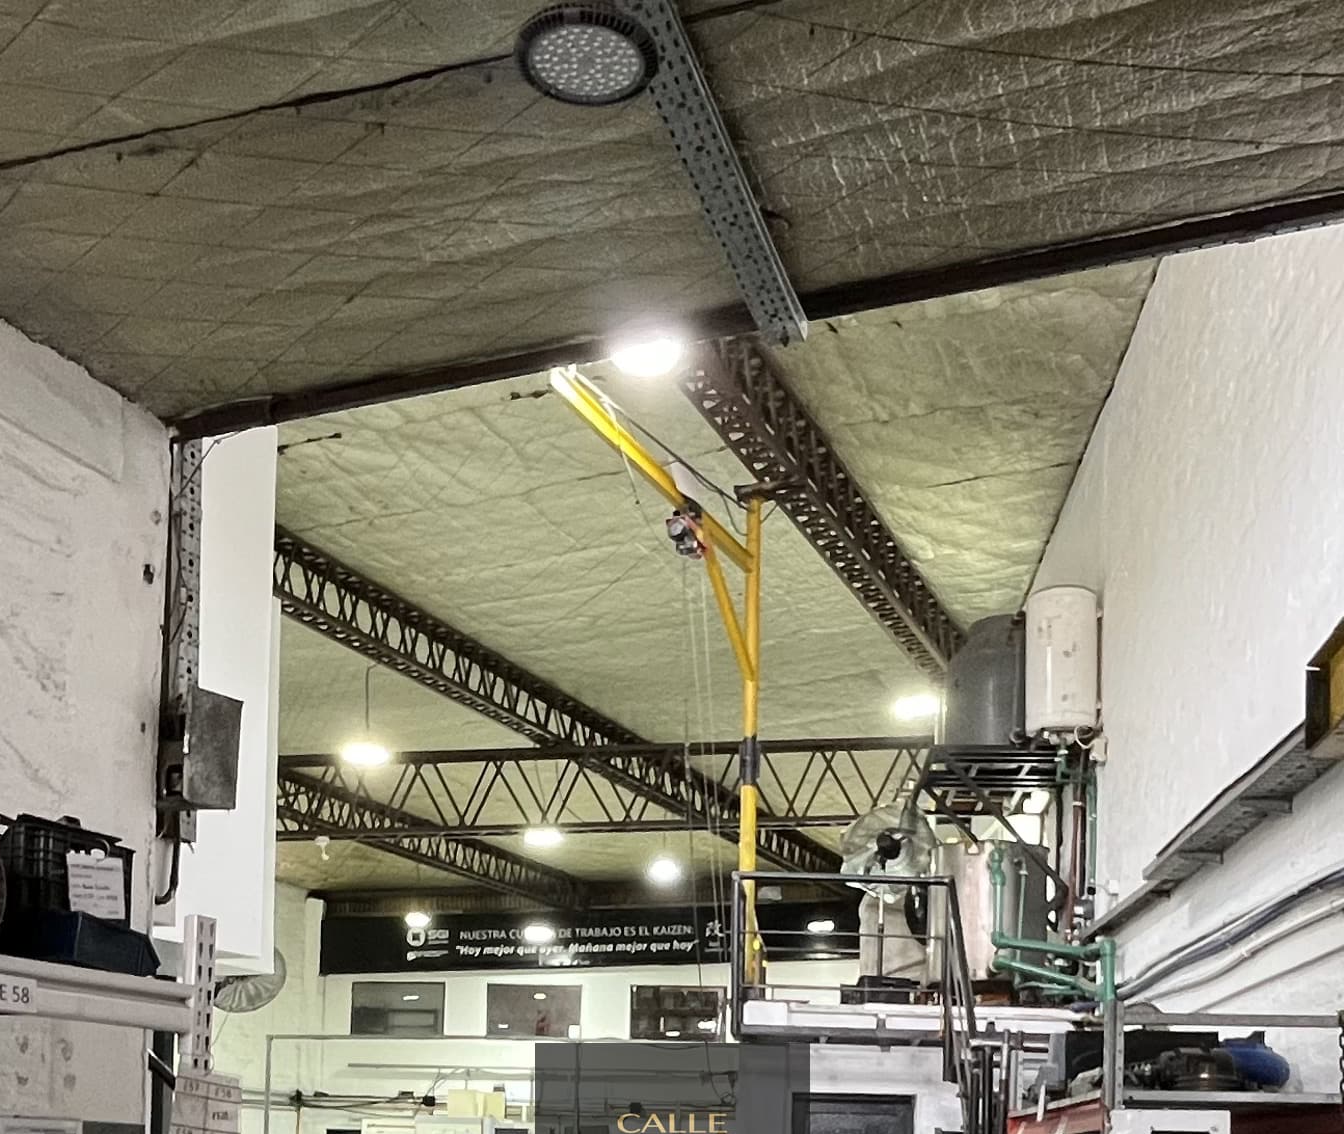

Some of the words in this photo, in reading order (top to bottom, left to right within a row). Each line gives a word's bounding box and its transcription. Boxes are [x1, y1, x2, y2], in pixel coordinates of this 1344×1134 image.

[459, 929, 507, 941] NUESTRA
[558, 927, 572, 938] DE
[575, 926, 622, 938] TRABAJO
[623, 926, 637, 937] ES
[638, 926, 651, 937] EL
[483, 944, 515, 957] mejor
[568, 940, 613, 954] Mañana
[615, 940, 648, 954] mejor
[649, 941, 671, 953] que
[0, 983, 8, 1001] E
[12, 985, 31, 1004] 58
